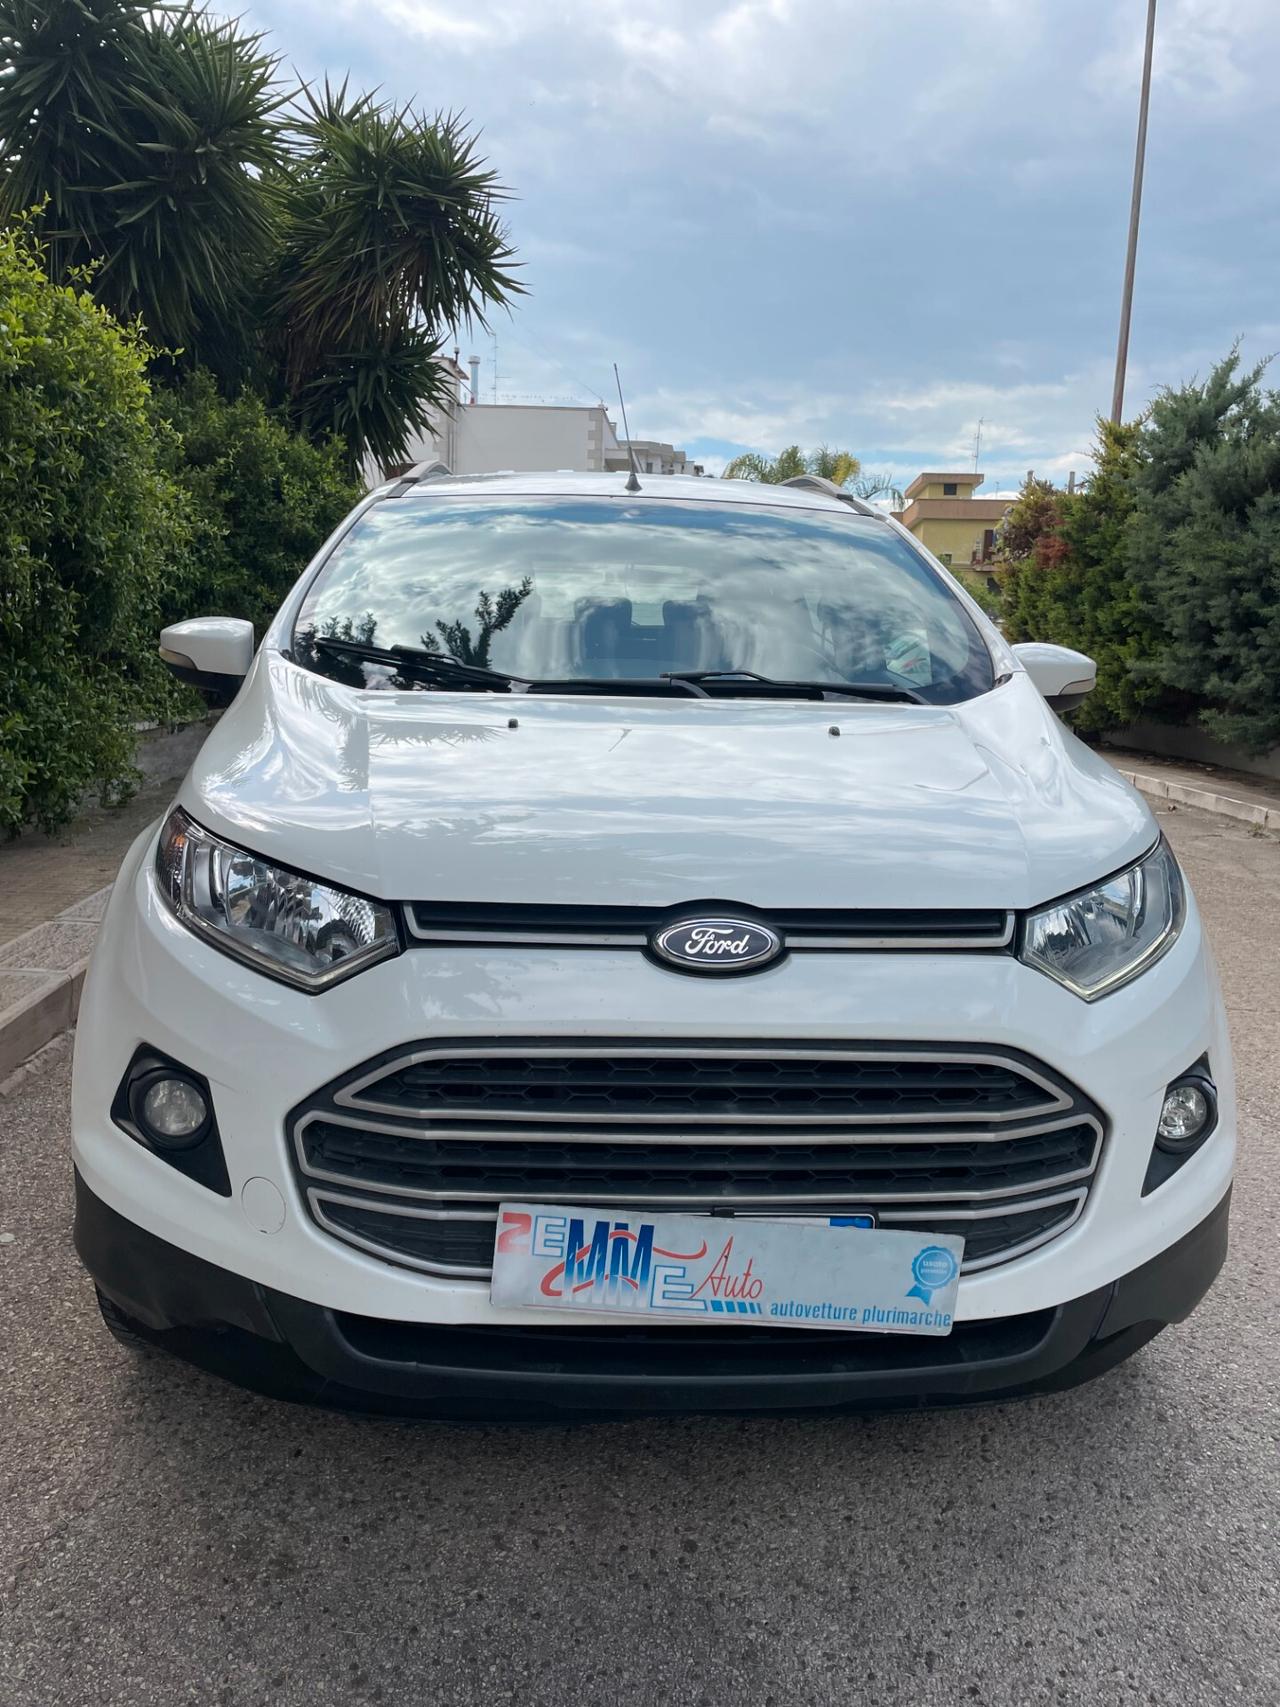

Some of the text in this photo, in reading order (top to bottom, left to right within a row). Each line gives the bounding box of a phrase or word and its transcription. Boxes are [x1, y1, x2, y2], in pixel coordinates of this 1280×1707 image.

[685, 927, 750, 954] Ford
[691, 1236, 763, 1300] Auto
[770, 1300, 951, 1327] autovetture plurimarche
